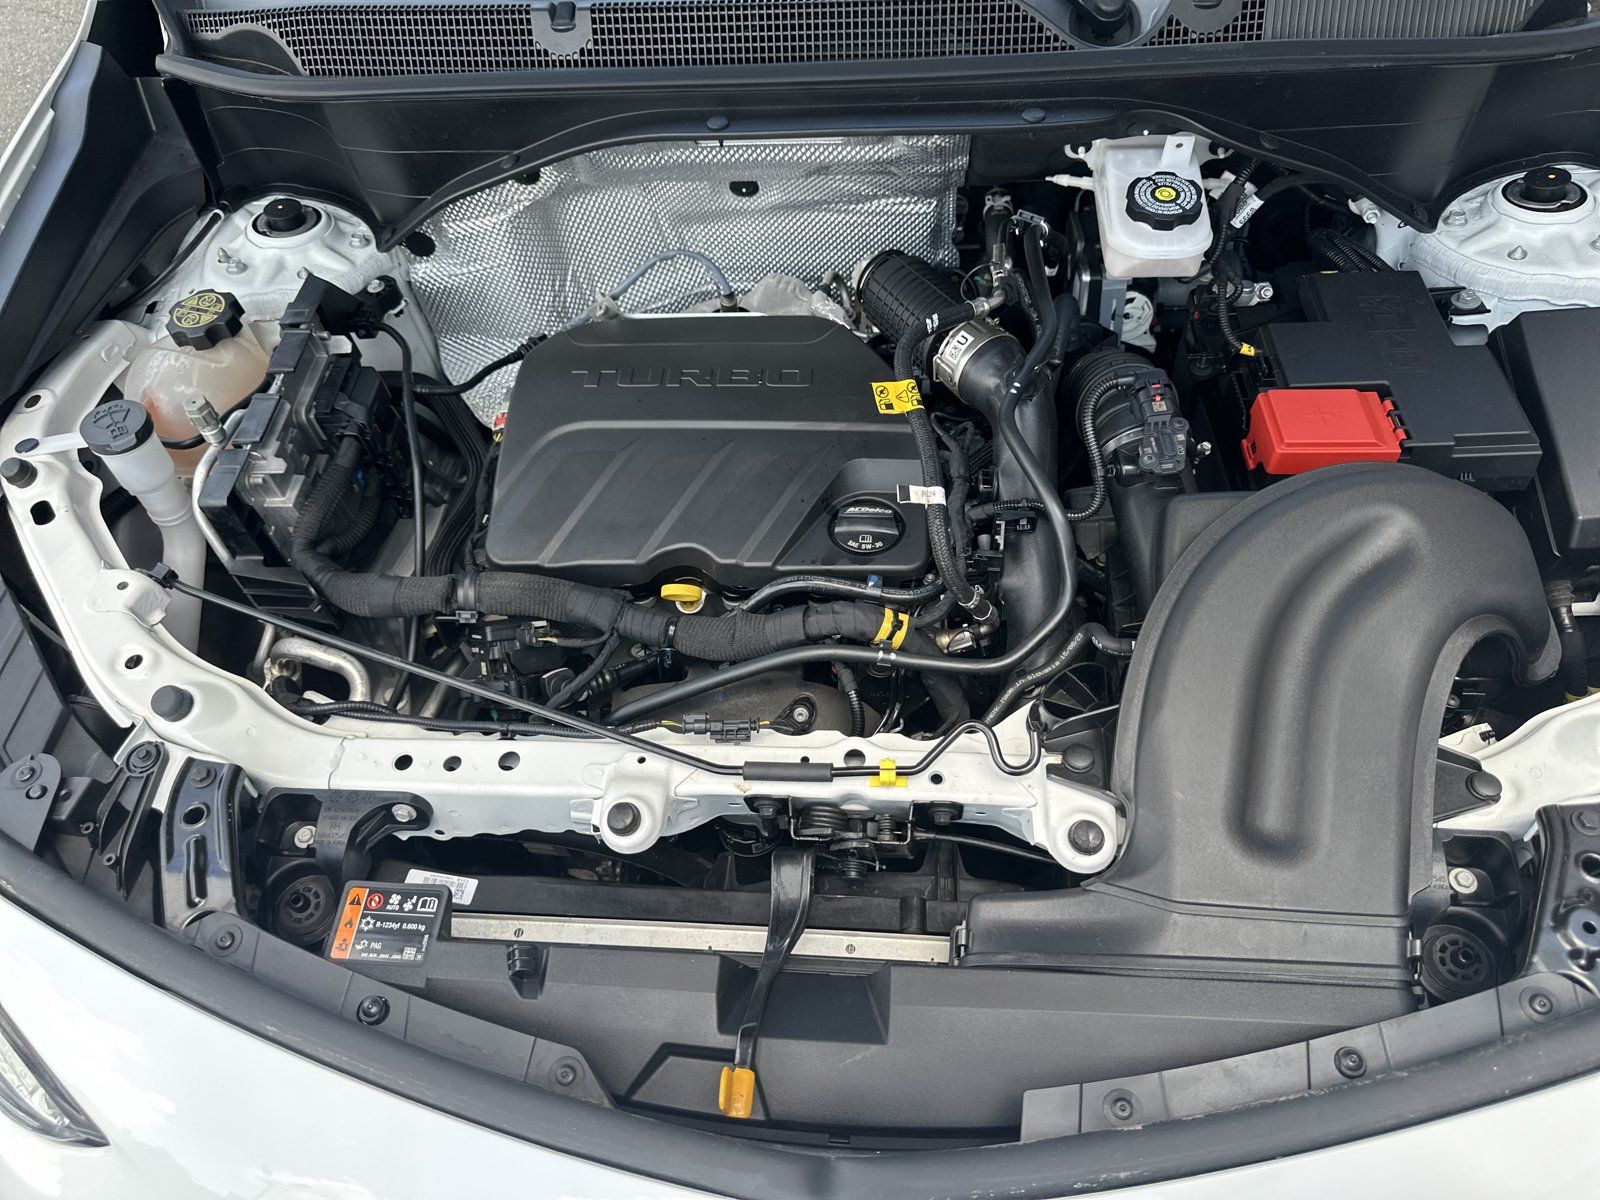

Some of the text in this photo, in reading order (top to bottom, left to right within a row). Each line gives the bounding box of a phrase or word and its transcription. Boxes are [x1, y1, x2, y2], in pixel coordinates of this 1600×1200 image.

[957, 334, 969, 346] U
[571, 368, 813, 388] TURBO
[845, 506, 893, 515] ACDelco
[847, 540, 860, 549] SAE
[376, 921, 401, 931] R-1234yf
[418, 923, 426, 932] kg
[370, 941, 383, 950] PAG
